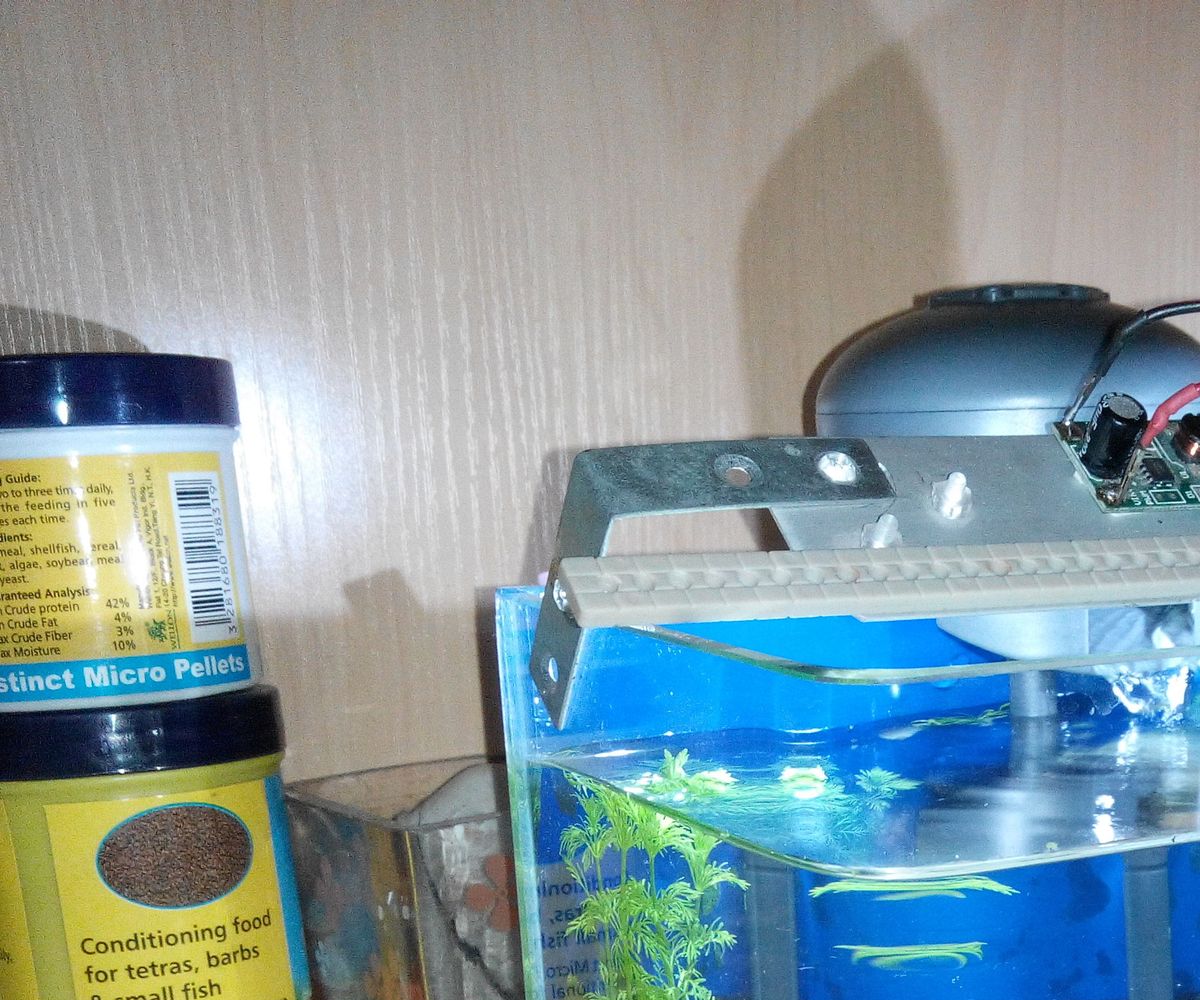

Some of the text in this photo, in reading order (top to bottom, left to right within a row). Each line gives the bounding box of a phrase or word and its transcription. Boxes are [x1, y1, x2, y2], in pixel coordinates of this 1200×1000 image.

[5, 473, 41, 484] Guide:
[11, 489, 22, 498] to
[24, 487, 53, 497] three
[55, 484, 84, 496] tim
[86, 483, 113, 495] daily,
[25, 500, 71, 511] feeding
[77, 499, 88, 508] in
[94, 497, 116, 507] five
[12, 515, 37, 526] each
[209, 485, 225, 545] 188319
[30, 543, 80, 556] shellfish,
[10, 559, 42, 572] algae,
[219, 555, 235, 617] 281680
[5, 598, 130, 616] Crude protein 42%
[7, 618, 42, 630] Crude
[41, 617, 58, 628] Fat
[114, 612, 132, 623] 4%
[11, 631, 43, 644] Crude
[45, 631, 73, 642] Fiber
[116, 626, 135, 637] 3%
[13, 645, 61, 658] Moisture
[112, 640, 137, 651] 10%
[83, 664, 167, 688] Micro
[174, 653, 245, 680] Pellets
[80, 908, 272, 956] Conditioning food
[84, 944, 260, 984] for tetras, barbs
[181, 978, 222, 1000] fish
